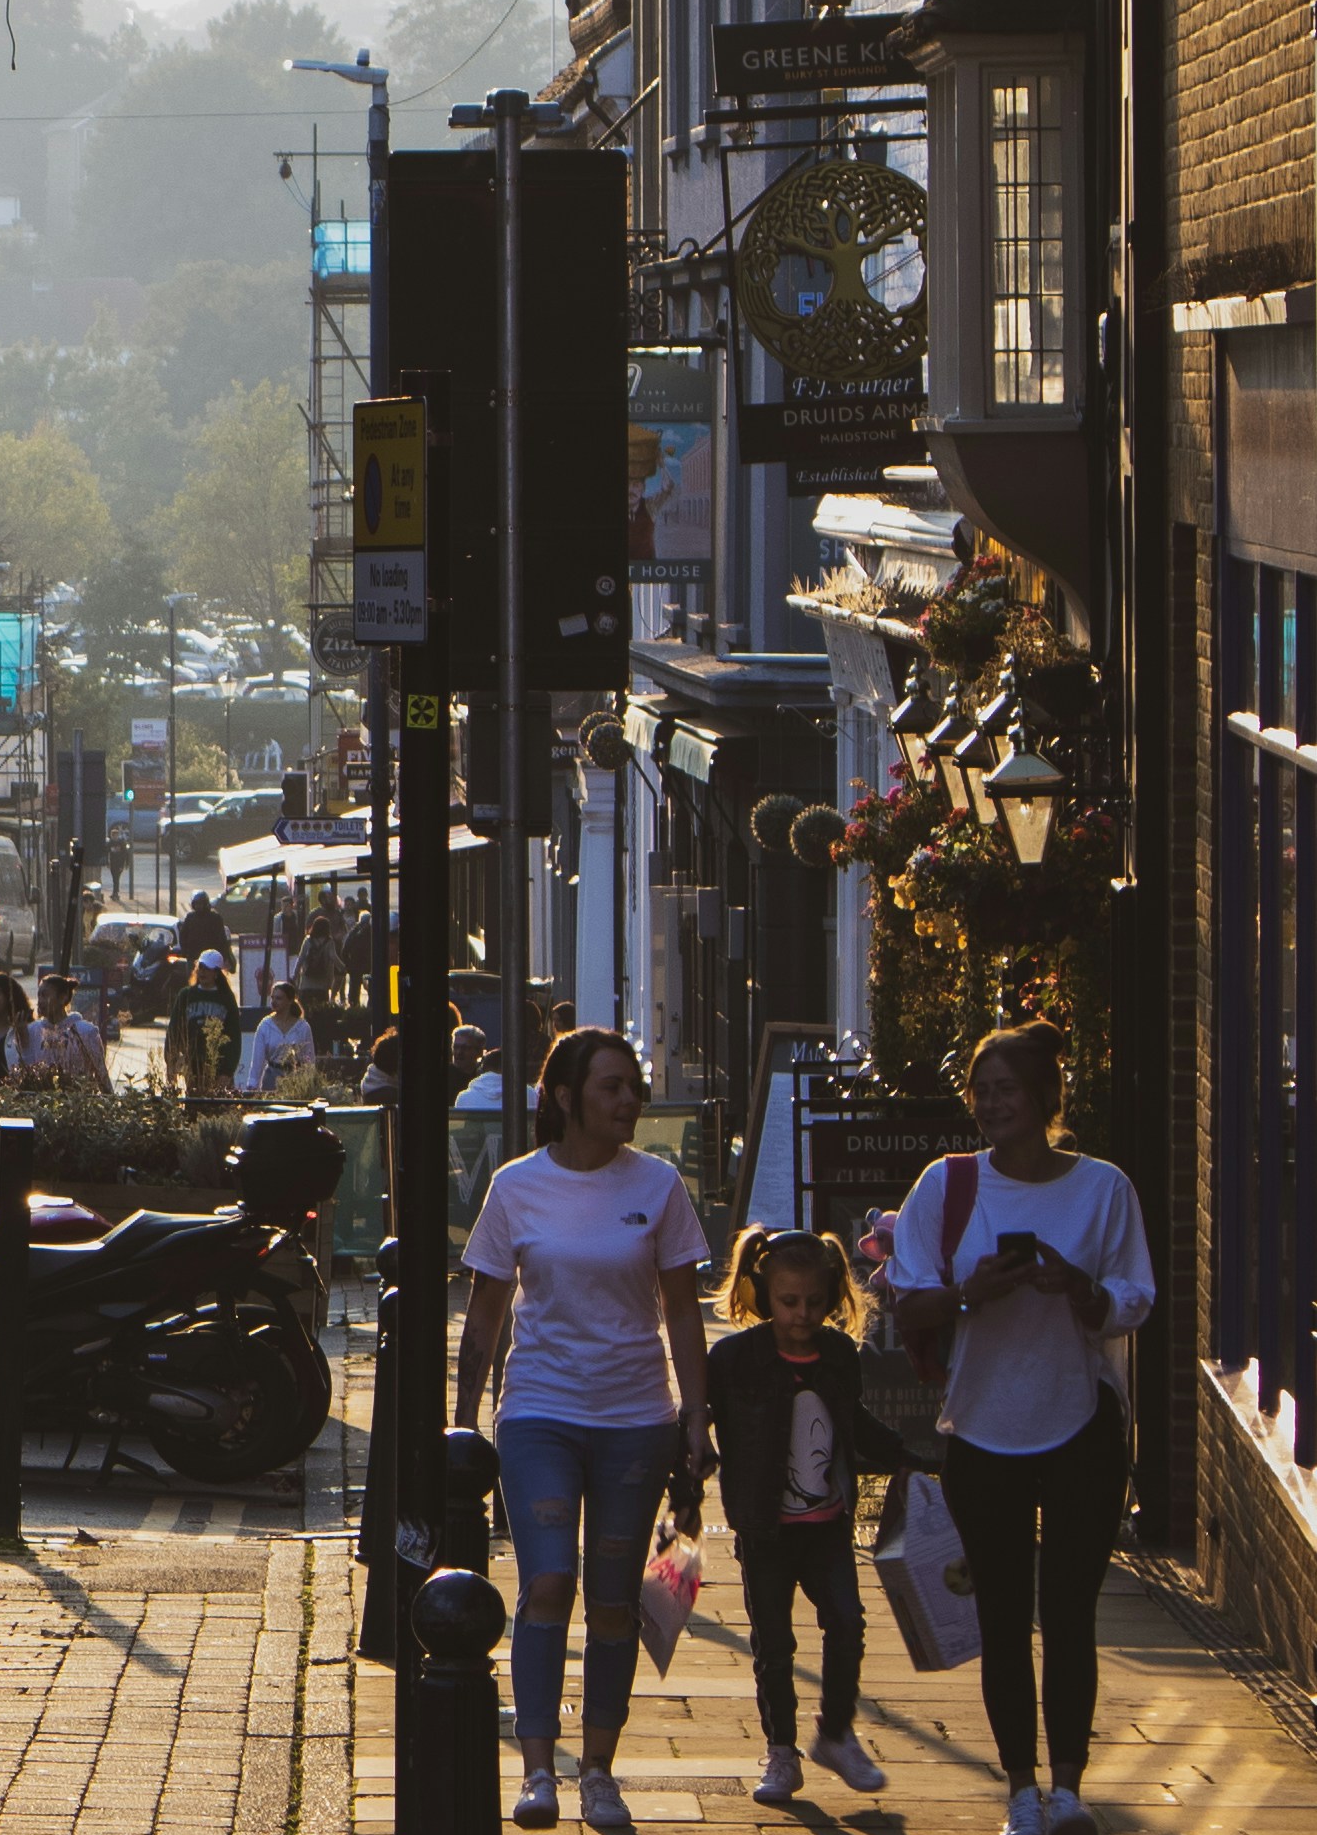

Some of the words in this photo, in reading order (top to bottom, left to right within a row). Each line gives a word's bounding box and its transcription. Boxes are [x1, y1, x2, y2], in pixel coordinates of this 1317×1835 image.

[741, 44, 849, 70] GREENE
[859, 42, 895, 63] KI
[784, 69, 812, 81] BURY
[814, 68, 830, 79] ST
[833, 65, 887, 78] EDMUNDS
[650, 403, 704, 413] NEAME
[783, 405, 865, 427] DRUIDS
[360, 416, 398, 442] Pedestrian
[398, 413, 417, 439] Zone
[820, 429, 898, 445] MAIDSTONE
[391, 463, 400, 487] At
[401, 467, 415, 492] any
[796, 466, 880, 483] Established
[394, 495, 411, 518] time
[370, 563, 381, 587] No
[381, 563, 408, 591] loading
[642, 565, 701, 577] HOUSE
[346, 750, 372, 762] FIV
[350, 769, 372, 777] HAM
[334, 822, 365, 831] TOILETS
[847, 1135, 929, 1153] DRUIDS
[935, 1134, 983, 1151] ARM
